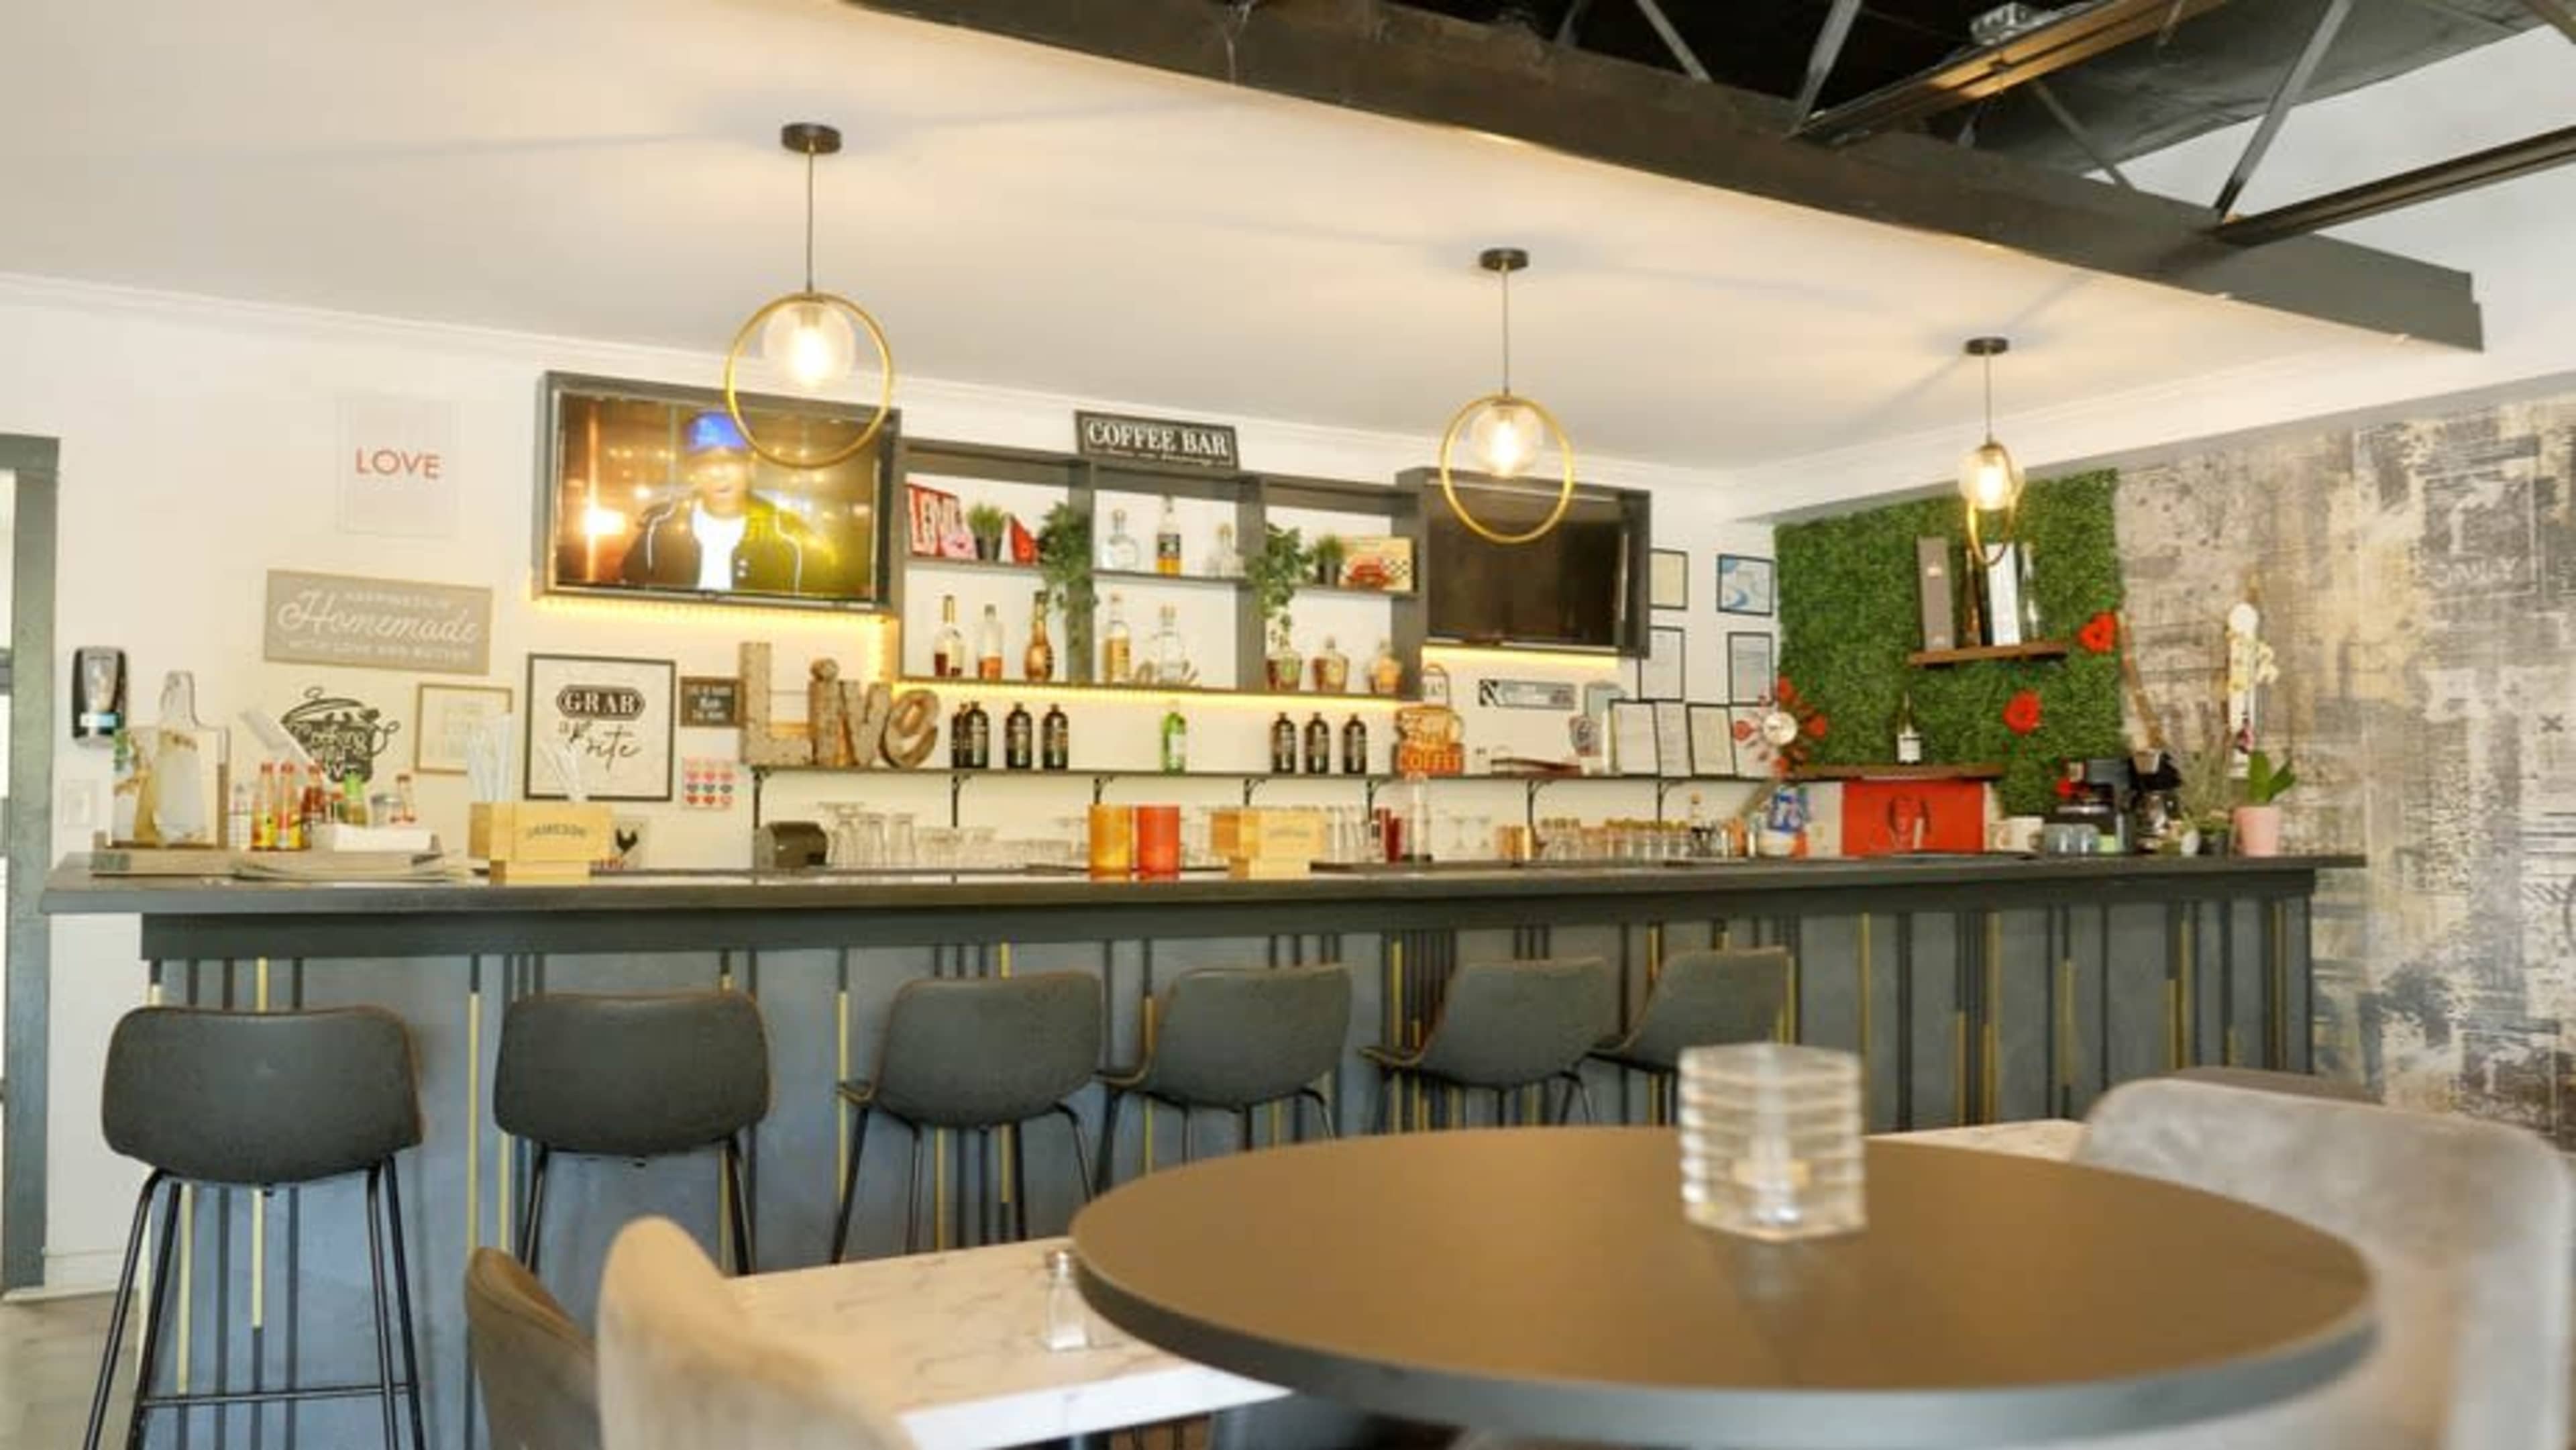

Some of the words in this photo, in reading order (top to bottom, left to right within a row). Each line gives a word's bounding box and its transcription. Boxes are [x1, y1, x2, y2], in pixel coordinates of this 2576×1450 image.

[1089, 420, 1177, 452] COFFEE
[1181, 428, 1228, 456] BAR
[356, 448, 442, 479] LOVE
[276, 589, 480, 643] Homemade
[565, 691, 635, 715] GRAB
[1397, 747, 1462, 772] COFFEE
[526, 823, 588, 839] JAMESON
